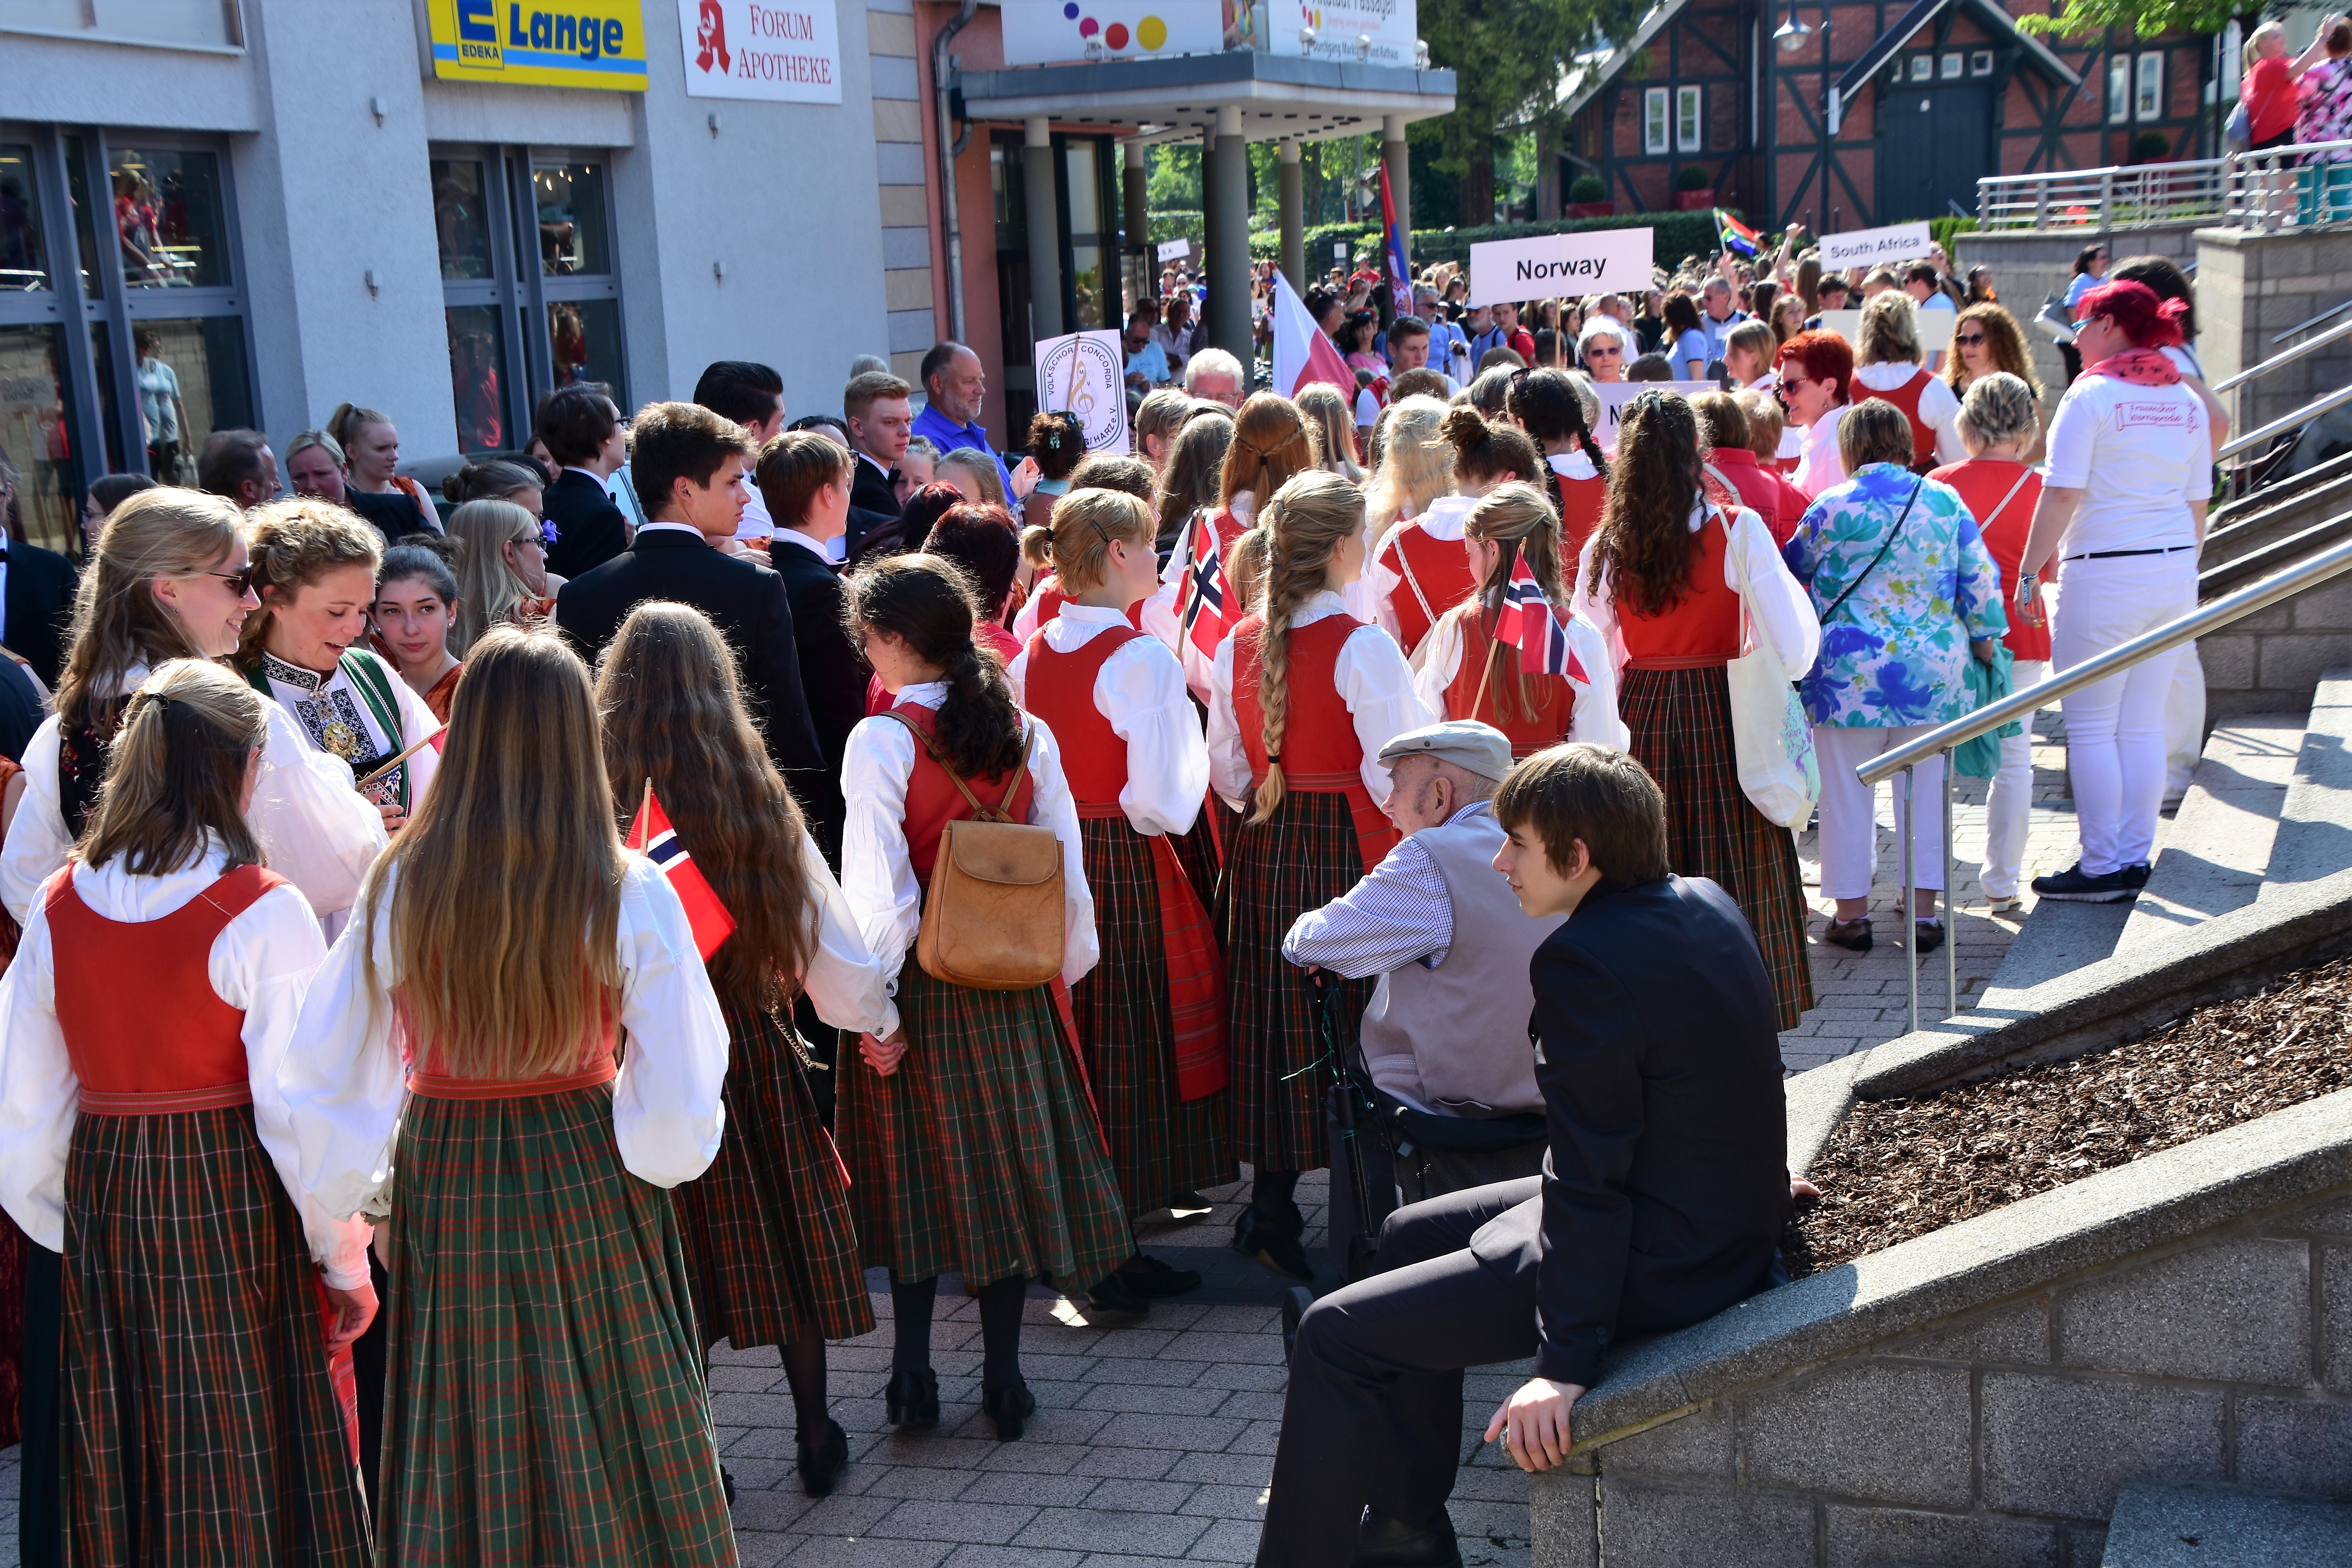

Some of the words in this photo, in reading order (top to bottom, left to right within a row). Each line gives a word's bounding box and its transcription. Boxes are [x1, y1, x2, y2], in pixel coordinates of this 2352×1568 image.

[510, 3, 623, 61] Lange
[749, 5, 813, 41] FORUM
[461, 44, 499, 59] EDEKA
[738, 47, 831, 85] APOTHEKE
[1830, 241, 1873, 258] South
[1877, 236, 1920, 252] Africa
[1517, 258, 1606, 281] Norway
[1047, 347, 1073, 396] VOLKSCHOR
[1081, 345, 1112, 389] CONCORDIA
